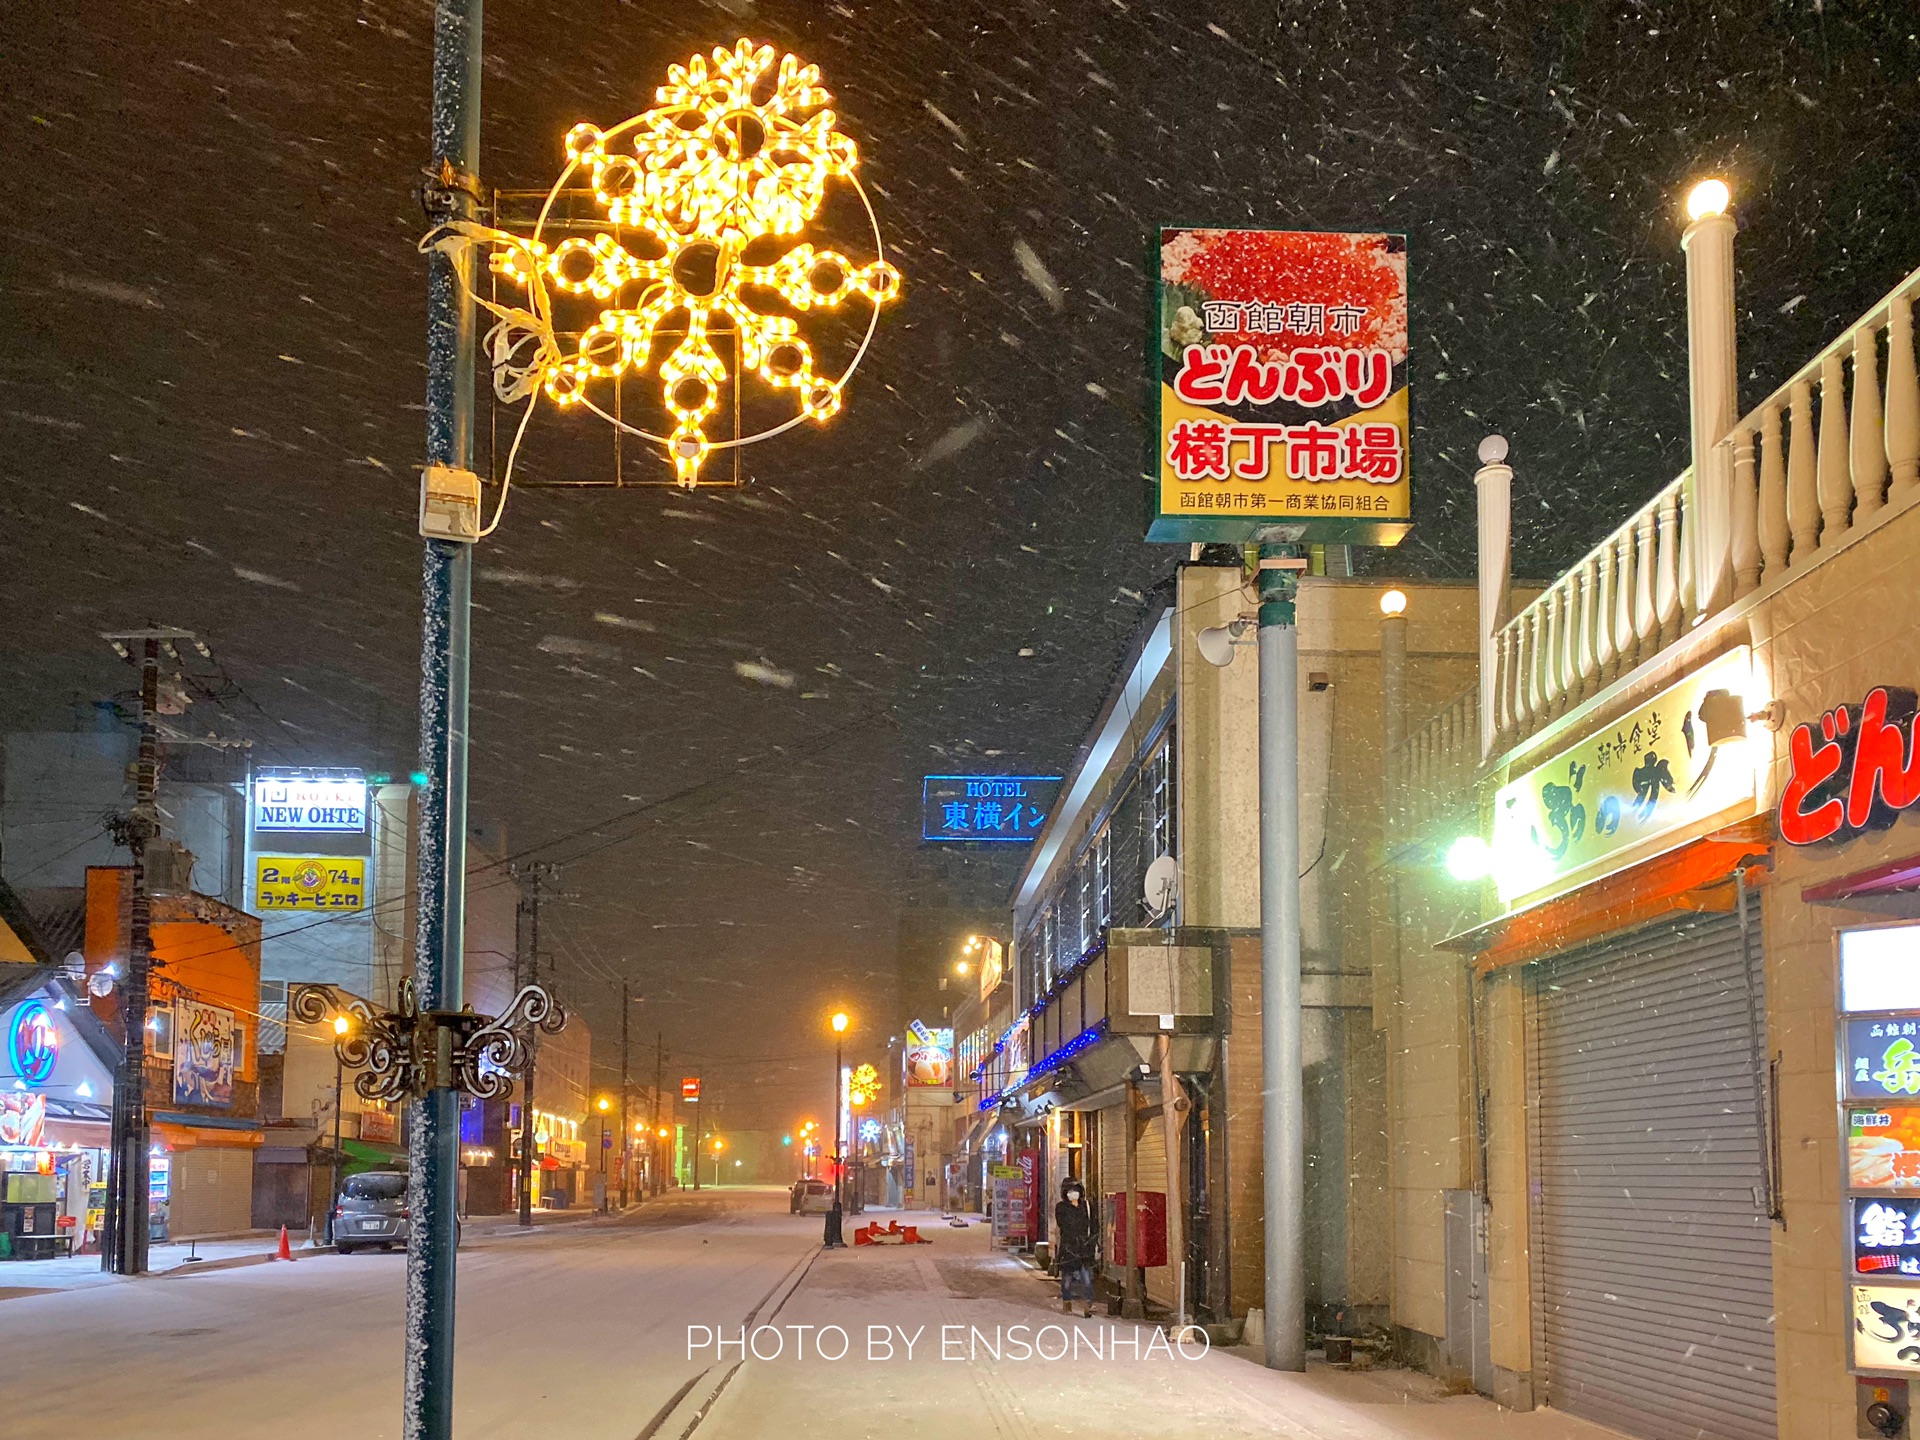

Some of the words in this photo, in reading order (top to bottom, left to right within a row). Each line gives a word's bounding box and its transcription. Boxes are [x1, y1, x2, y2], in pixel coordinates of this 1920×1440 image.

[1202, 300, 1368, 336] 函館朝市
[1176, 346, 1389, 404] どんぶり
[1169, 422, 1401, 480] 横丁市場
[1179, 490, 1391, 512] 函館朝市第一商業協同組合
[1596, 711, 1663, 771] 朝市食堂
[965, 782, 1027, 798] HOTEL
[261, 806, 303, 823] NEW
[307, 806, 359, 824] OHTE
[941, 801, 1046, 831] 東横イン
[260, 891, 359, 906] ラッキーピエロ
[1853, 1113, 1891, 1127] 海鮮丼
